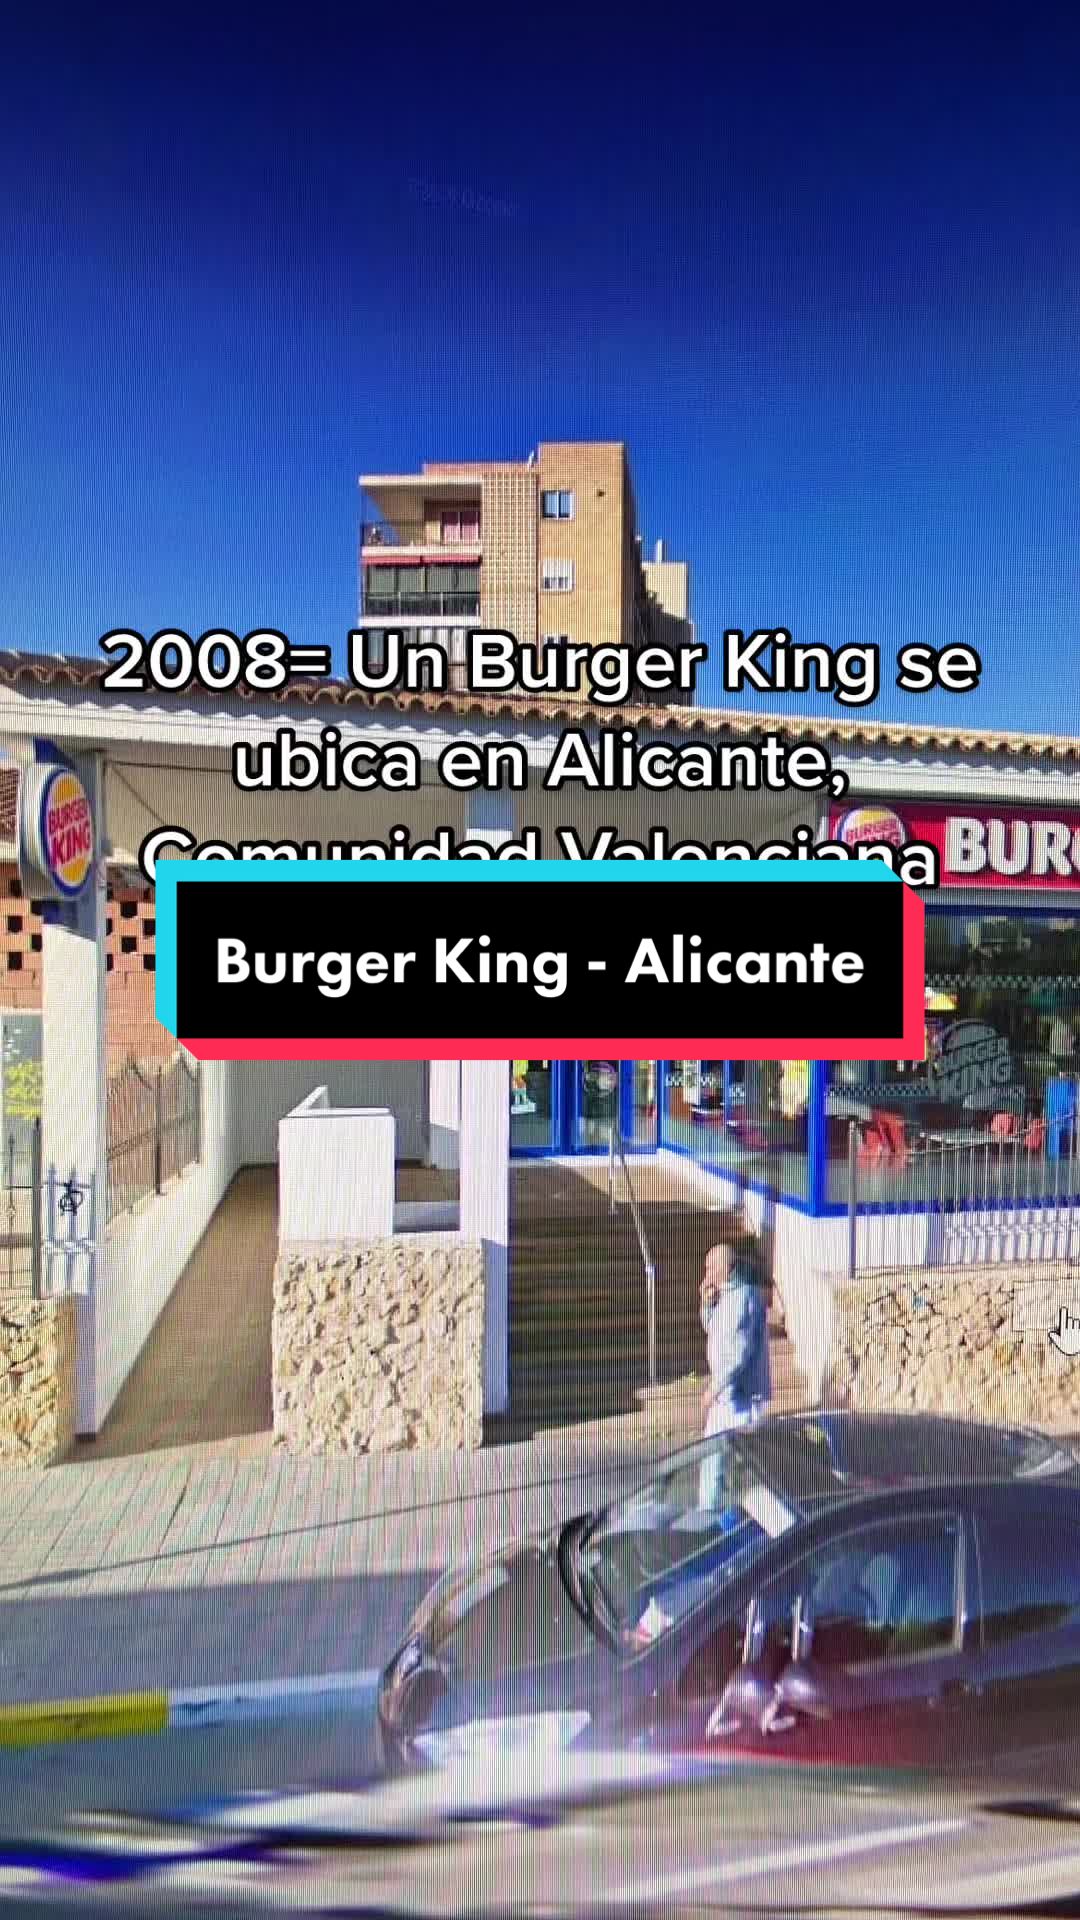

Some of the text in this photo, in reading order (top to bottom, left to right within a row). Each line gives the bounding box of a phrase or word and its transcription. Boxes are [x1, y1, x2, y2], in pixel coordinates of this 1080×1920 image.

[49, 798, 87, 836] BURGER
[53, 818, 90, 864] KING
[944, 815, 1080, 877] BUR
[940, 1056, 1012, 1103] KING
